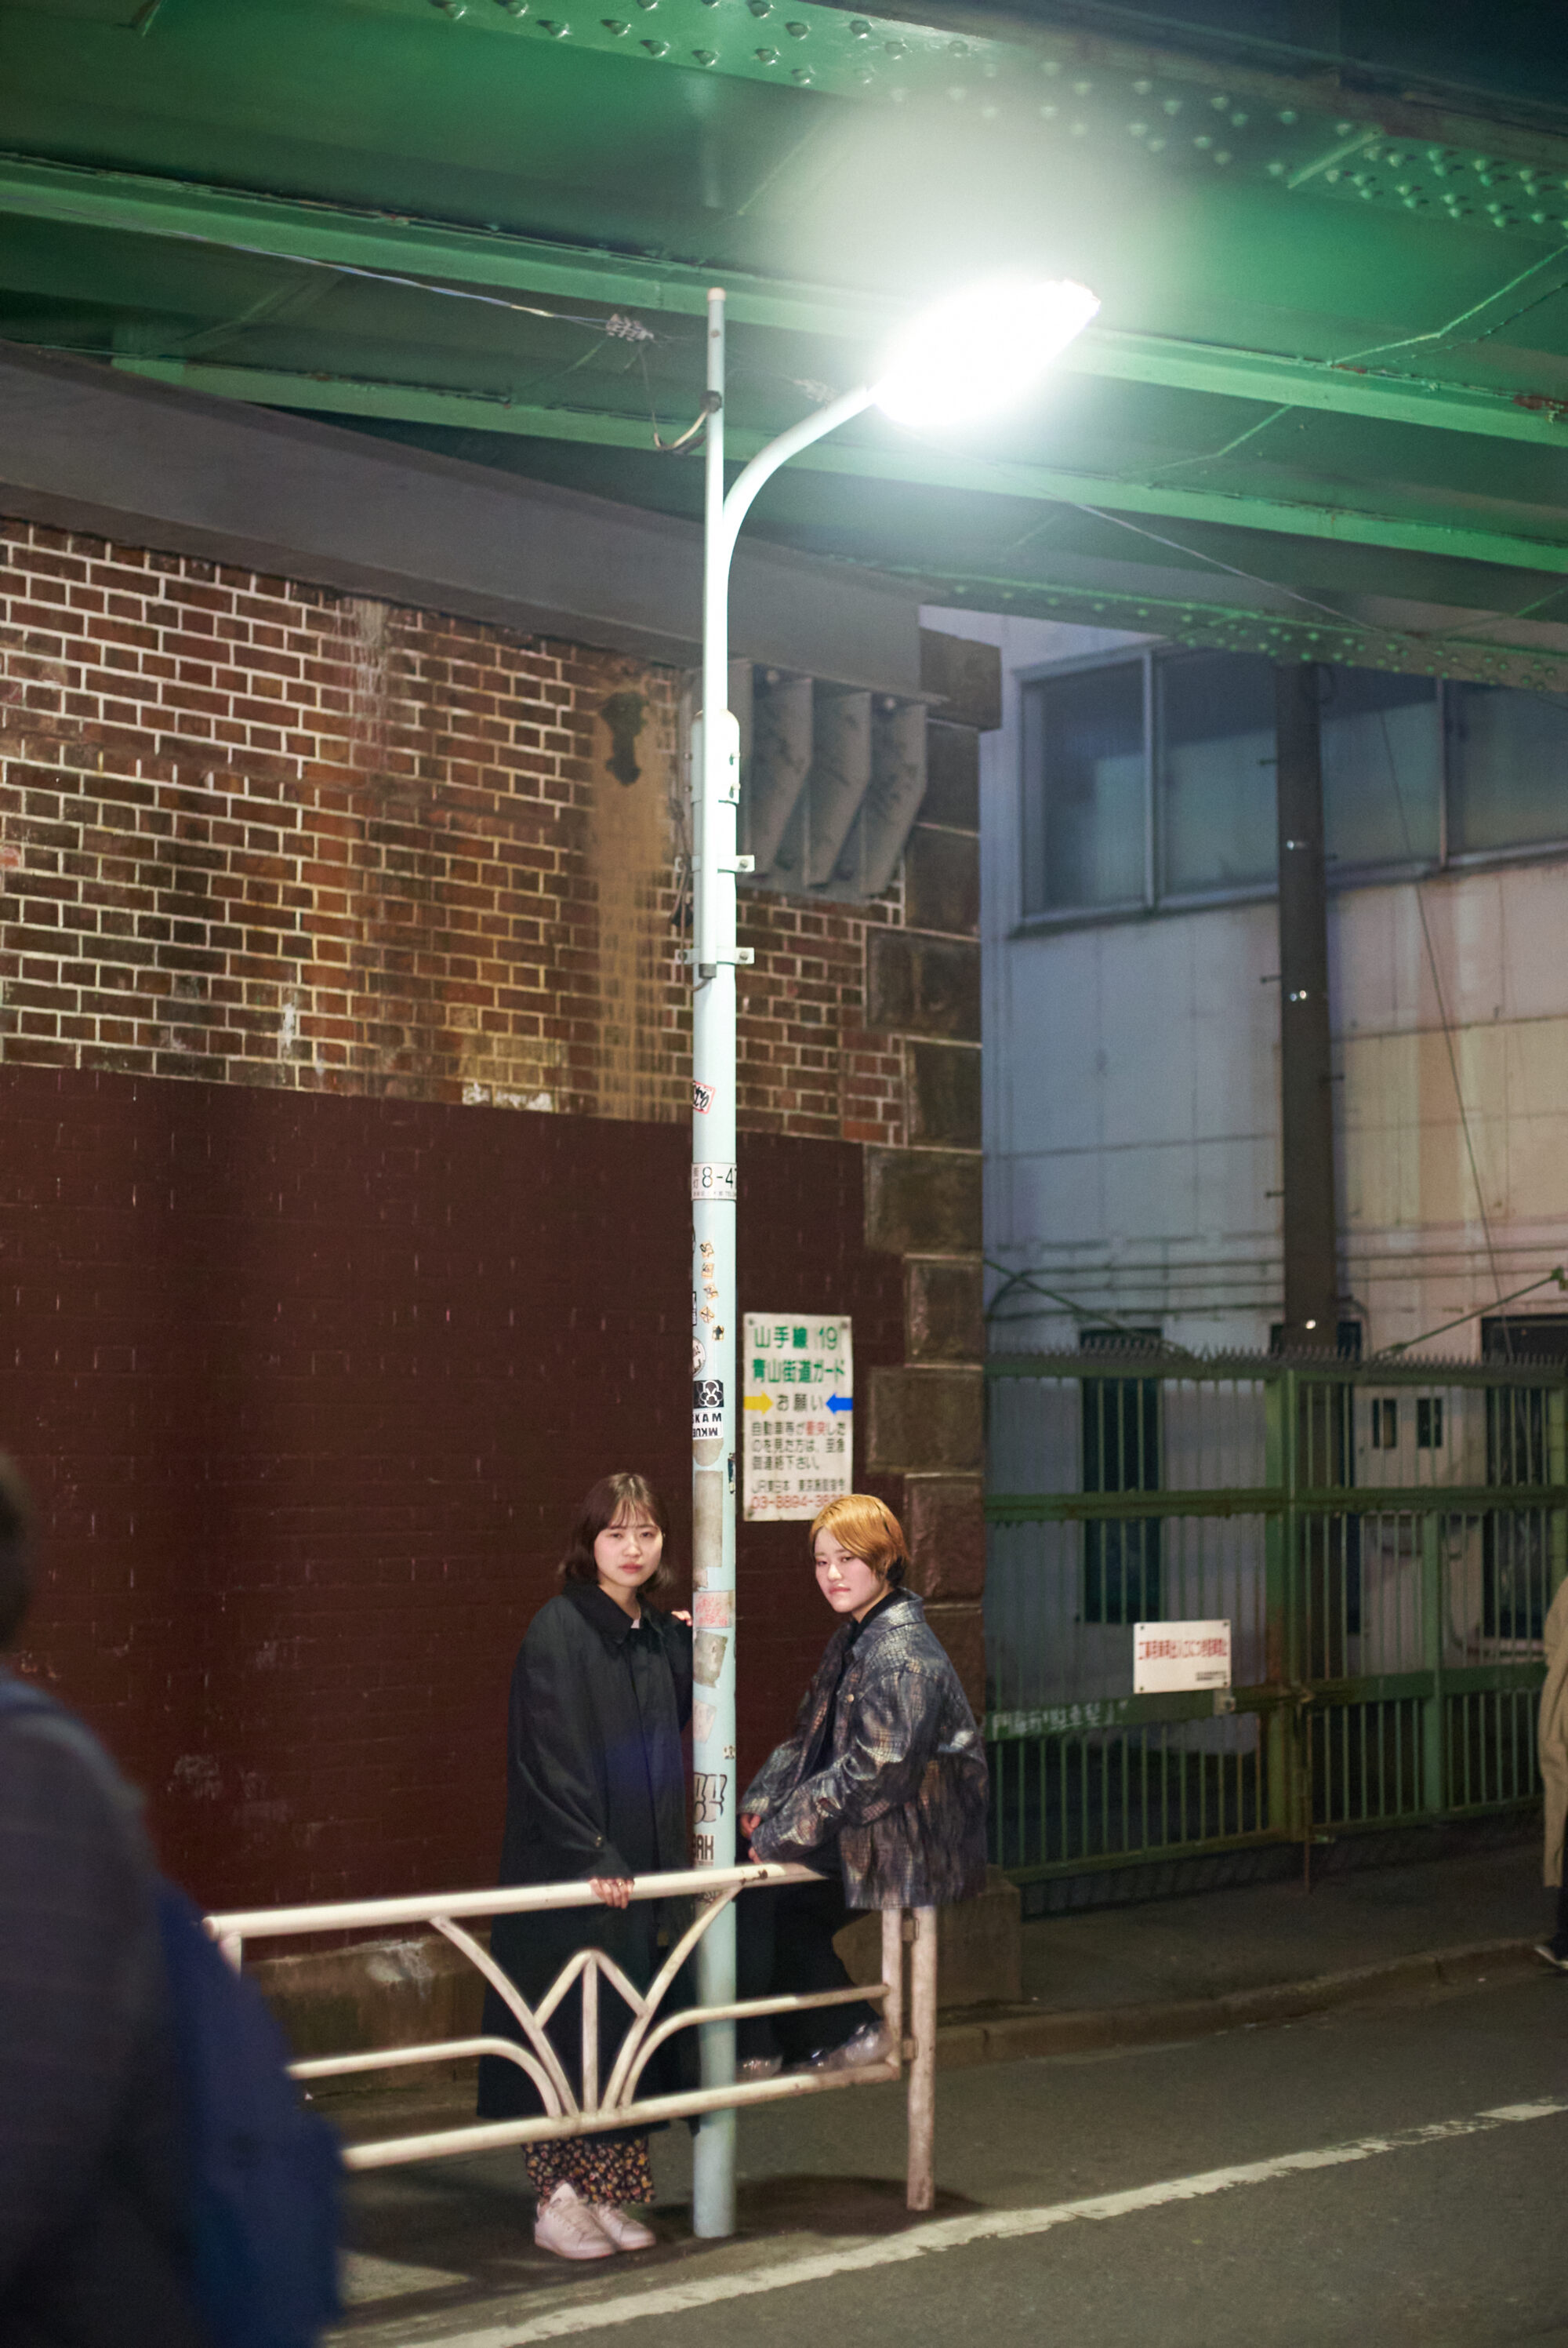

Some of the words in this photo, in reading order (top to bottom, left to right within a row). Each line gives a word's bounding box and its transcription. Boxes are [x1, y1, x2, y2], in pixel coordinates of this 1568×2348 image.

[702, 1166, 736, 1189] 8-4
[754, 1326, 807, 1349] 山手線
[818, 1326, 837, 1350] 19
[753, 1358, 845, 1383] 青山街道ガード
[777, 1394, 823, 1412] お願い
